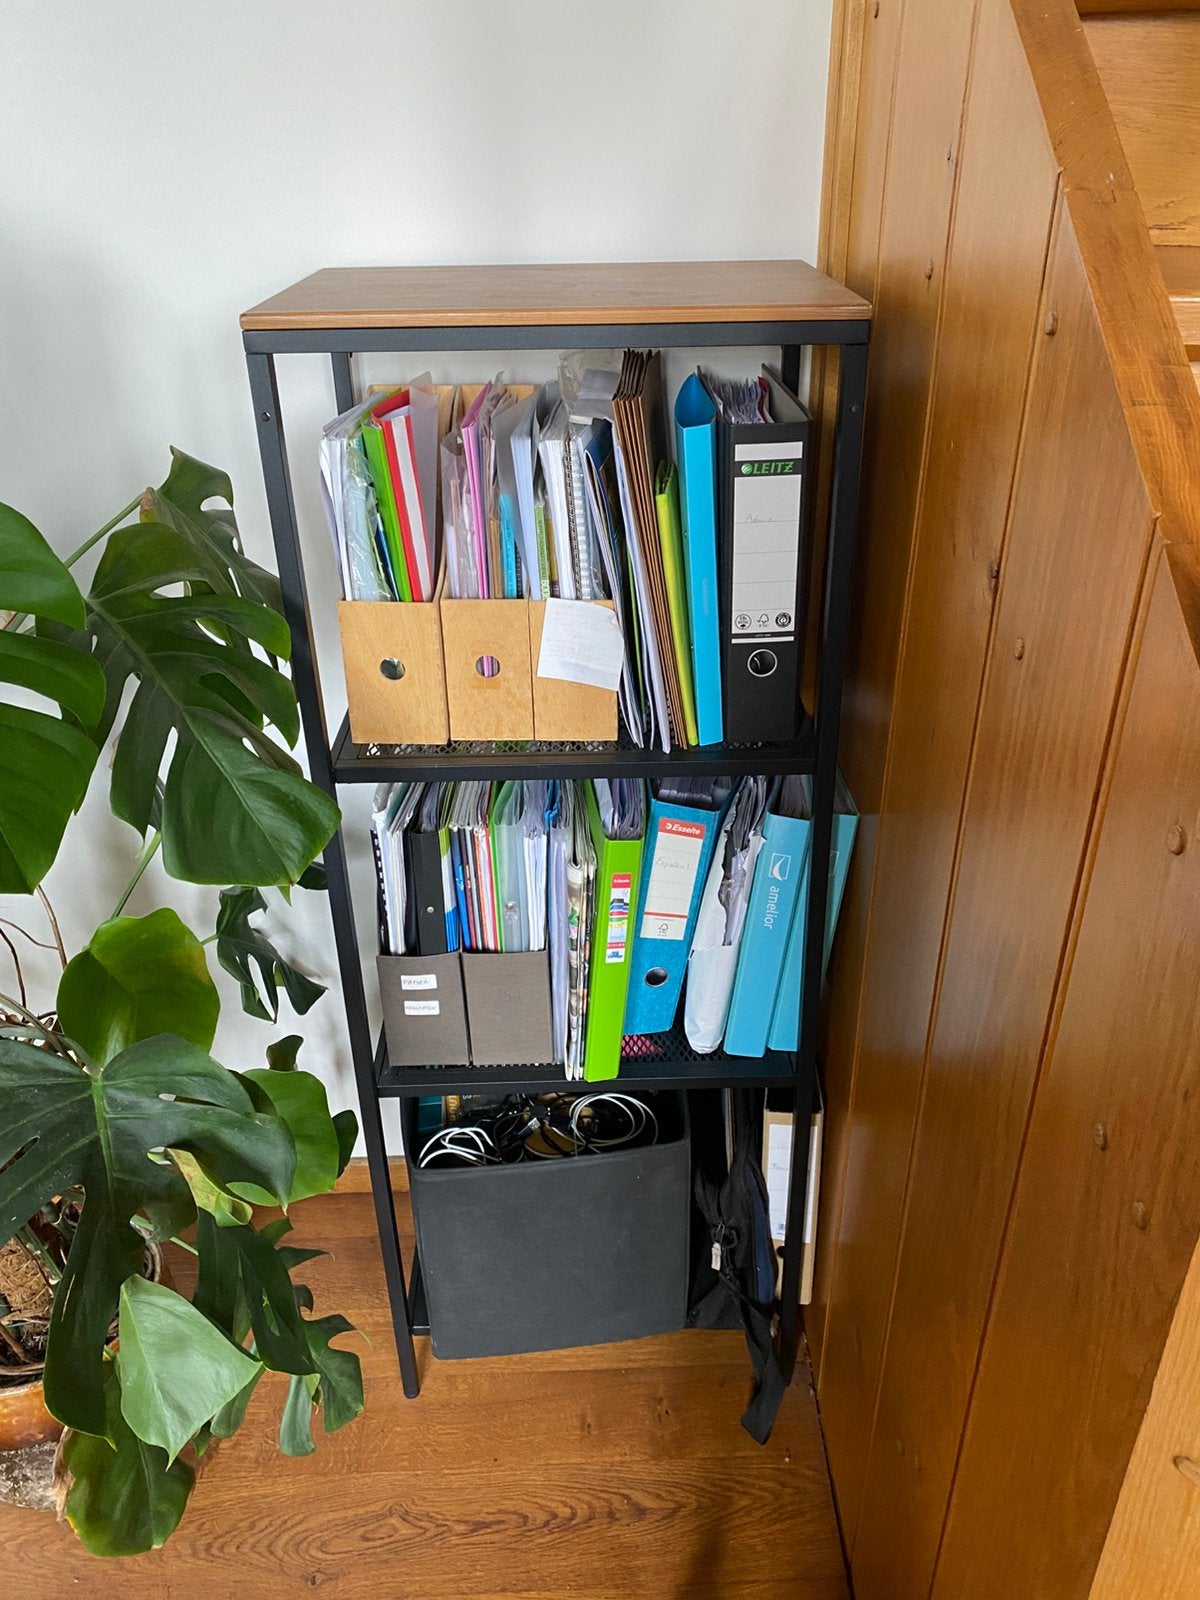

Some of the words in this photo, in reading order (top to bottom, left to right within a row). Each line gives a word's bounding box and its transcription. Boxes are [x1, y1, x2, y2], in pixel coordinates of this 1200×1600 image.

[752, 461, 795, 474] LEITZ
[671, 824, 701, 836] Esselte
[764, 886, 780, 929] amelior
